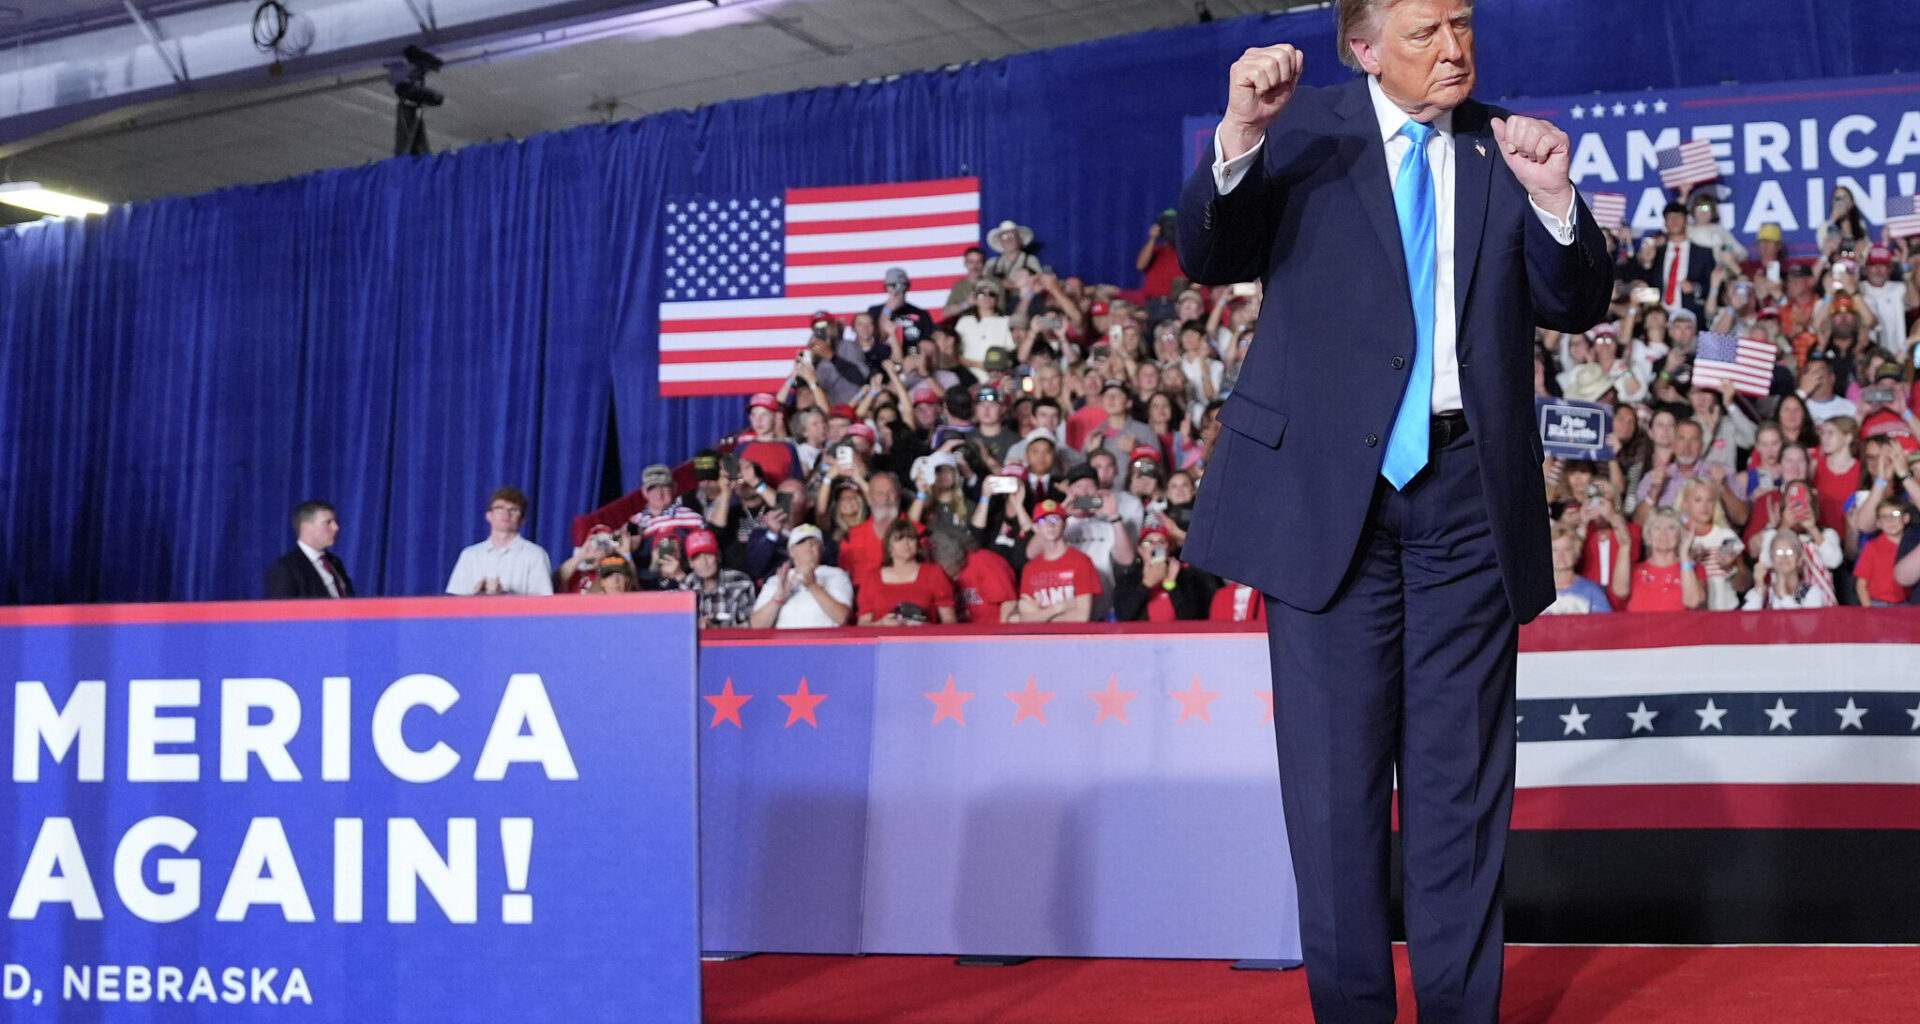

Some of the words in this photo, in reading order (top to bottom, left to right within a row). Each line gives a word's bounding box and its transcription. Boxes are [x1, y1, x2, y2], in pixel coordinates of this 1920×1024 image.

[12, 673, 579, 783] MERICA
[8, 816, 534, 924] AGAIN!
[2, 964, 43, 1006] D,
[62, 965, 313, 1005] NEBRASKA
